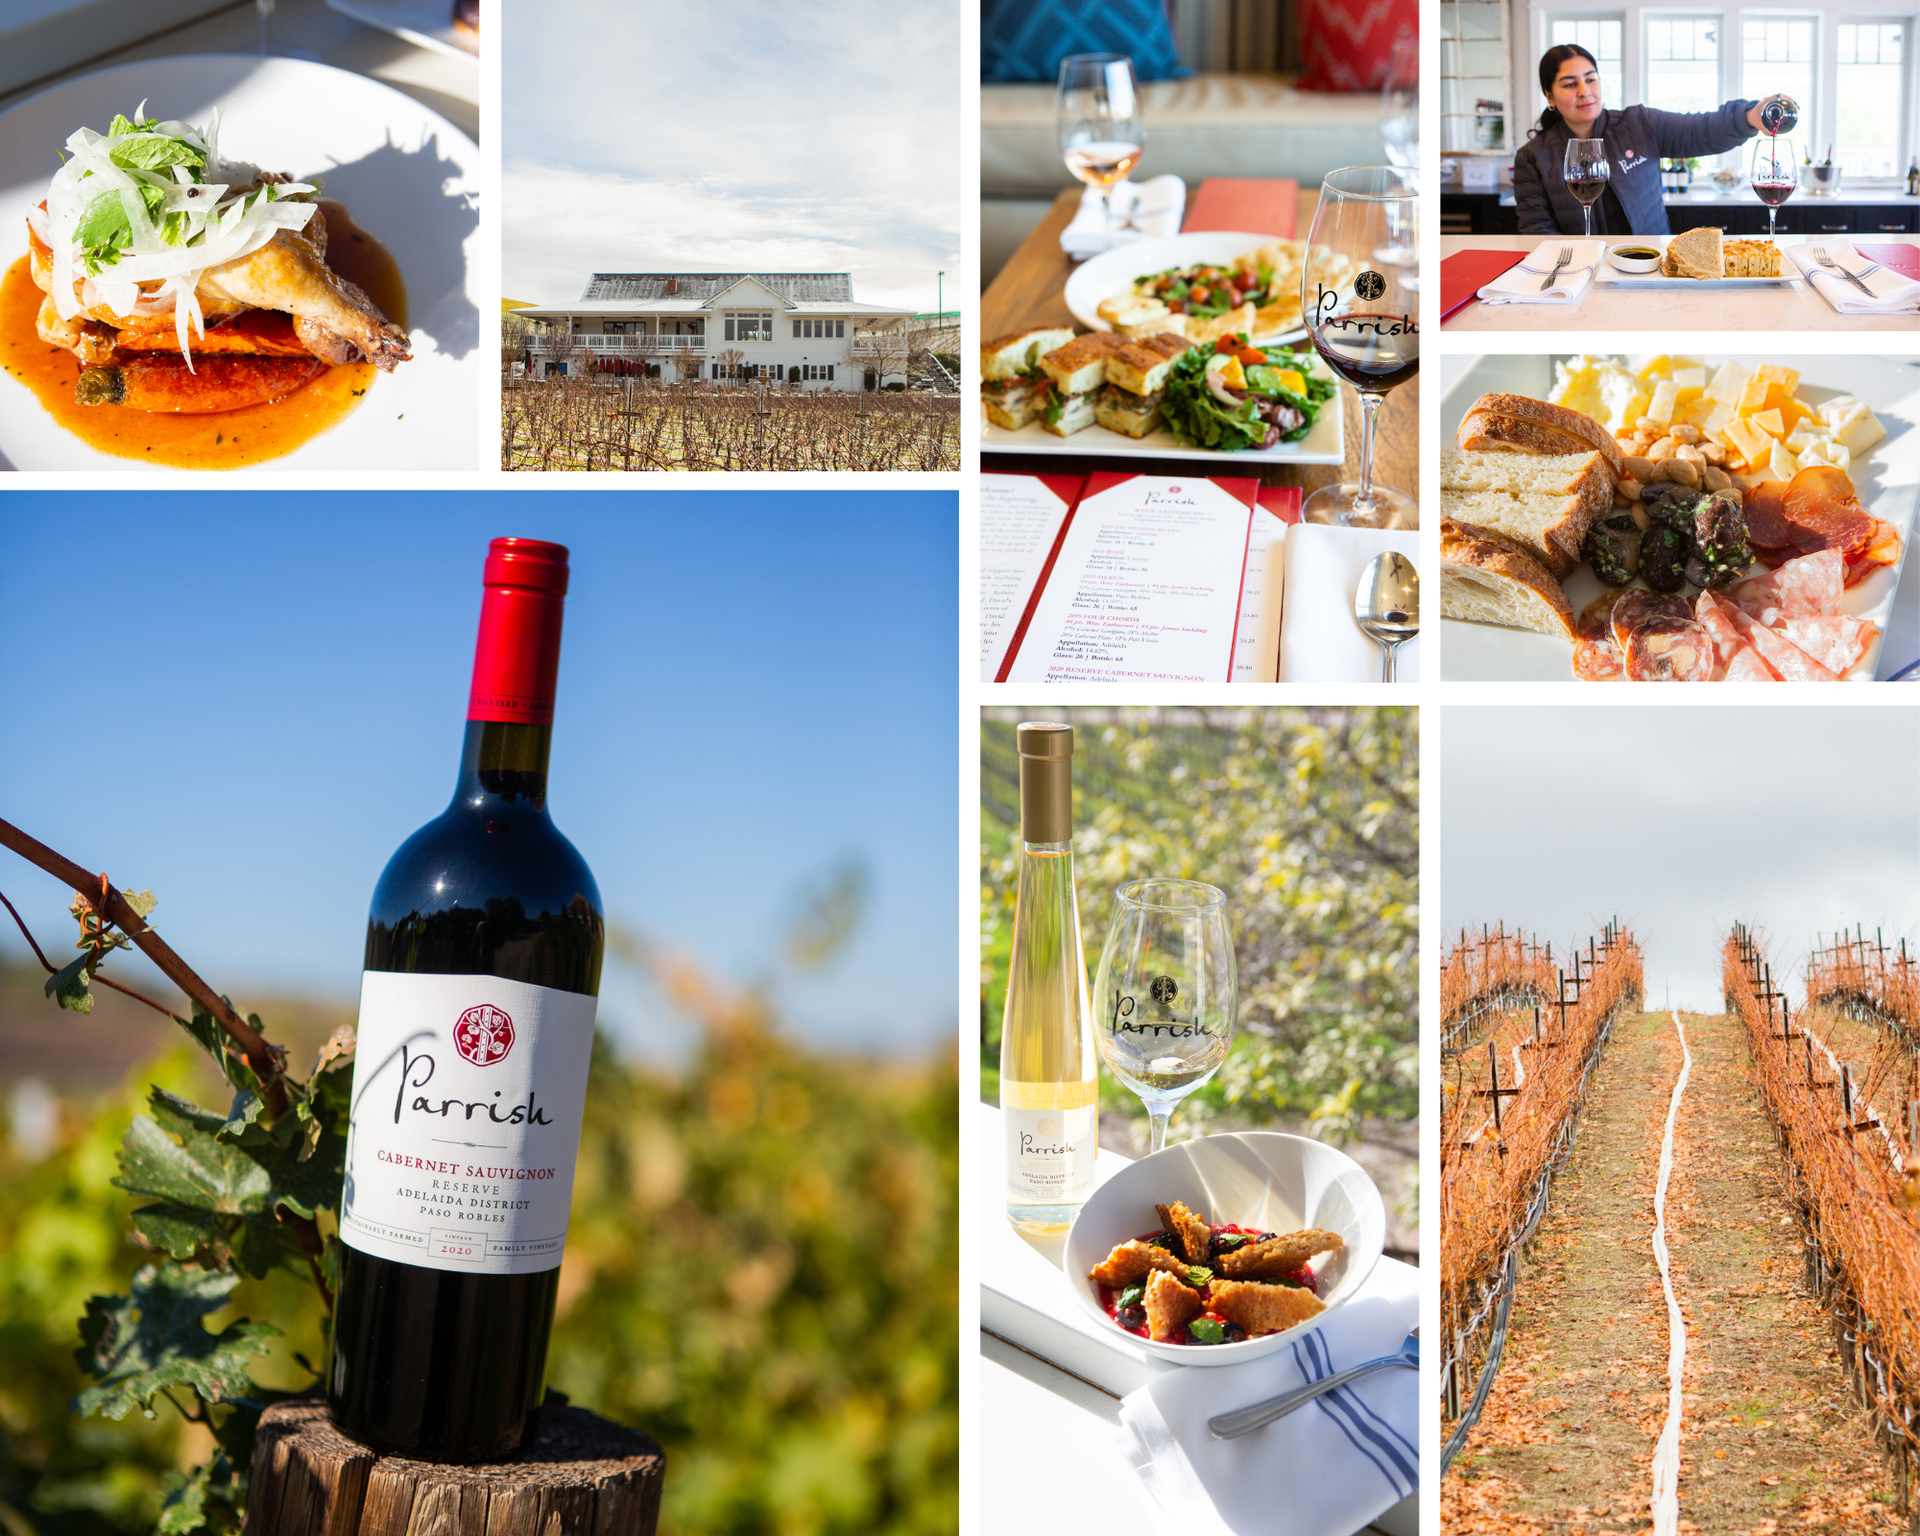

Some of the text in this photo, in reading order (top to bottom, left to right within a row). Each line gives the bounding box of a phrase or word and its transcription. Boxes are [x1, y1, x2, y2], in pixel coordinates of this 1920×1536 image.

[1618, 156, 1648, 174] Parrish
[1316, 282, 1419, 336] Parrish
[1145, 490, 1198, 506] Parrish
[1045, 672, 1088, 681] Appellation:
[1066, 666, 1104, 675] RESERVE
[1105, 670, 1152, 678] CABERNET
[1153, 672, 1204, 682] SAUVIGNON
[476, 698, 518, 708] VINEYARD
[1113, 990, 1212, 1038] Parrish
[394, 1044, 554, 1126] Parrish
[1020, 1131, 1076, 1156] Parrish
[377, 1150, 556, 1180] CABERNET SAUVIGNON
[1018, 1164, 1056, 1172] SAUVIGNON
[432, 1179, 500, 1196] RESERVE
[396, 1187, 531, 1210] ADELAIDA DISTRICT
[420, 1206, 506, 1222] PASO ROBLES
[389, 1231, 424, 1243] FARMED
[441, 1245, 472, 1256] 2020
[529, 1241, 558, 1250] VINEYARD
